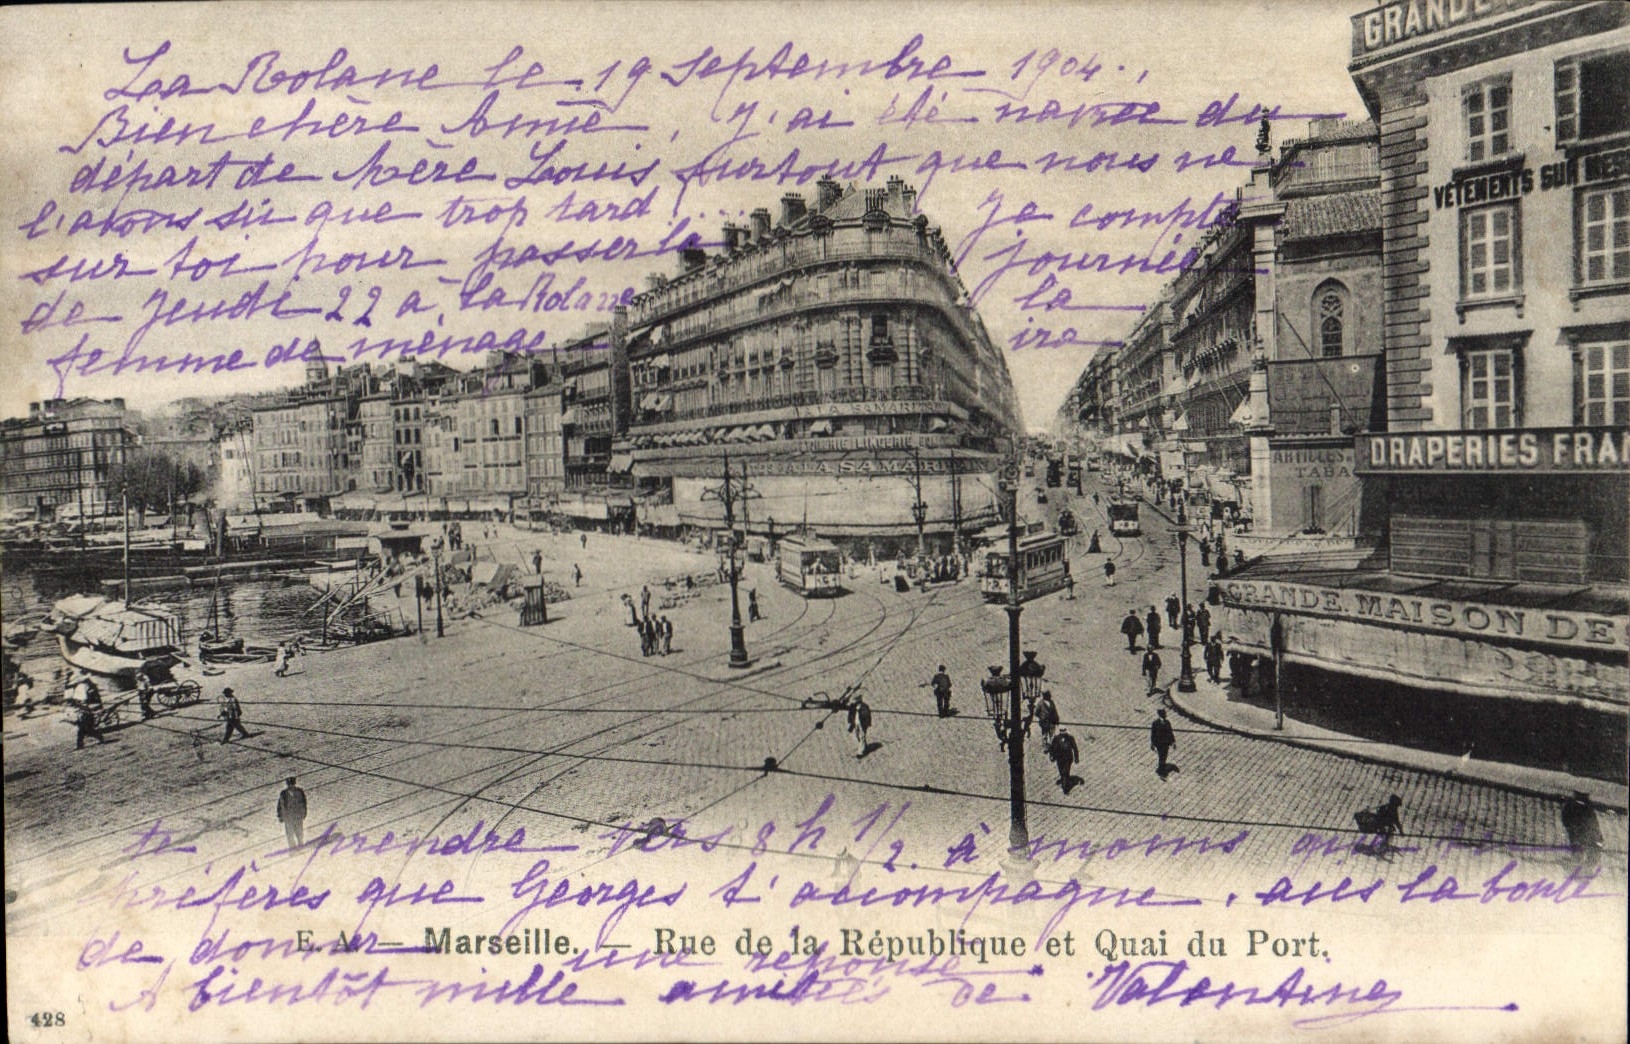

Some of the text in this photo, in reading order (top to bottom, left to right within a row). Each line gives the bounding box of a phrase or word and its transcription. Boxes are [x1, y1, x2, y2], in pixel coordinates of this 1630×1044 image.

[104, 40, 205, 101] La
[483, 45, 575, 90] le
[594, 56, 652, 112] 19
[59, 104, 222, 154] Bien
[1196, 93, 1346, 128] du
[69, 149, 236, 200] départ
[234, 152, 323, 190] de
[504, 139, 660, 190] Louis
[915, 149, 1026, 200] que
[1035, 152, 1160, 175] nous
[1174, 146, 1295, 172] ne
[304, 200, 426, 233] que
[435, 196, 528, 232] trop
[20, 252, 157, 285] sur
[163, 234, 278, 281] toi
[282, 237, 446, 281] pour
[474, 236, 652, 274] passer
[652, 216, 735, 256] la
[21, 290, 123, 334] de
[324, 285, 383, 327] 22
[1012, 273, 1146, 311] la
[47, 333, 256, 385] femme
[265, 337, 345, 367] de
[1010, 317, 1124, 351] ira
[1370, 431, 1538, 467] DRAPERIES
[1354, 593, 1526, 635] MAISON
[124, 820, 197, 859] te
[264, 820, 578, 872] prendre
[944, 822, 992, 868] à
[1009, 812, 1249, 861] moins
[357, 877, 484, 915] que
[505, 860, 688, 930] Georges
[1398, 865, 1478, 903] la
[415, 963, 625, 1008] mille
[562, 947, 722, 973] une
